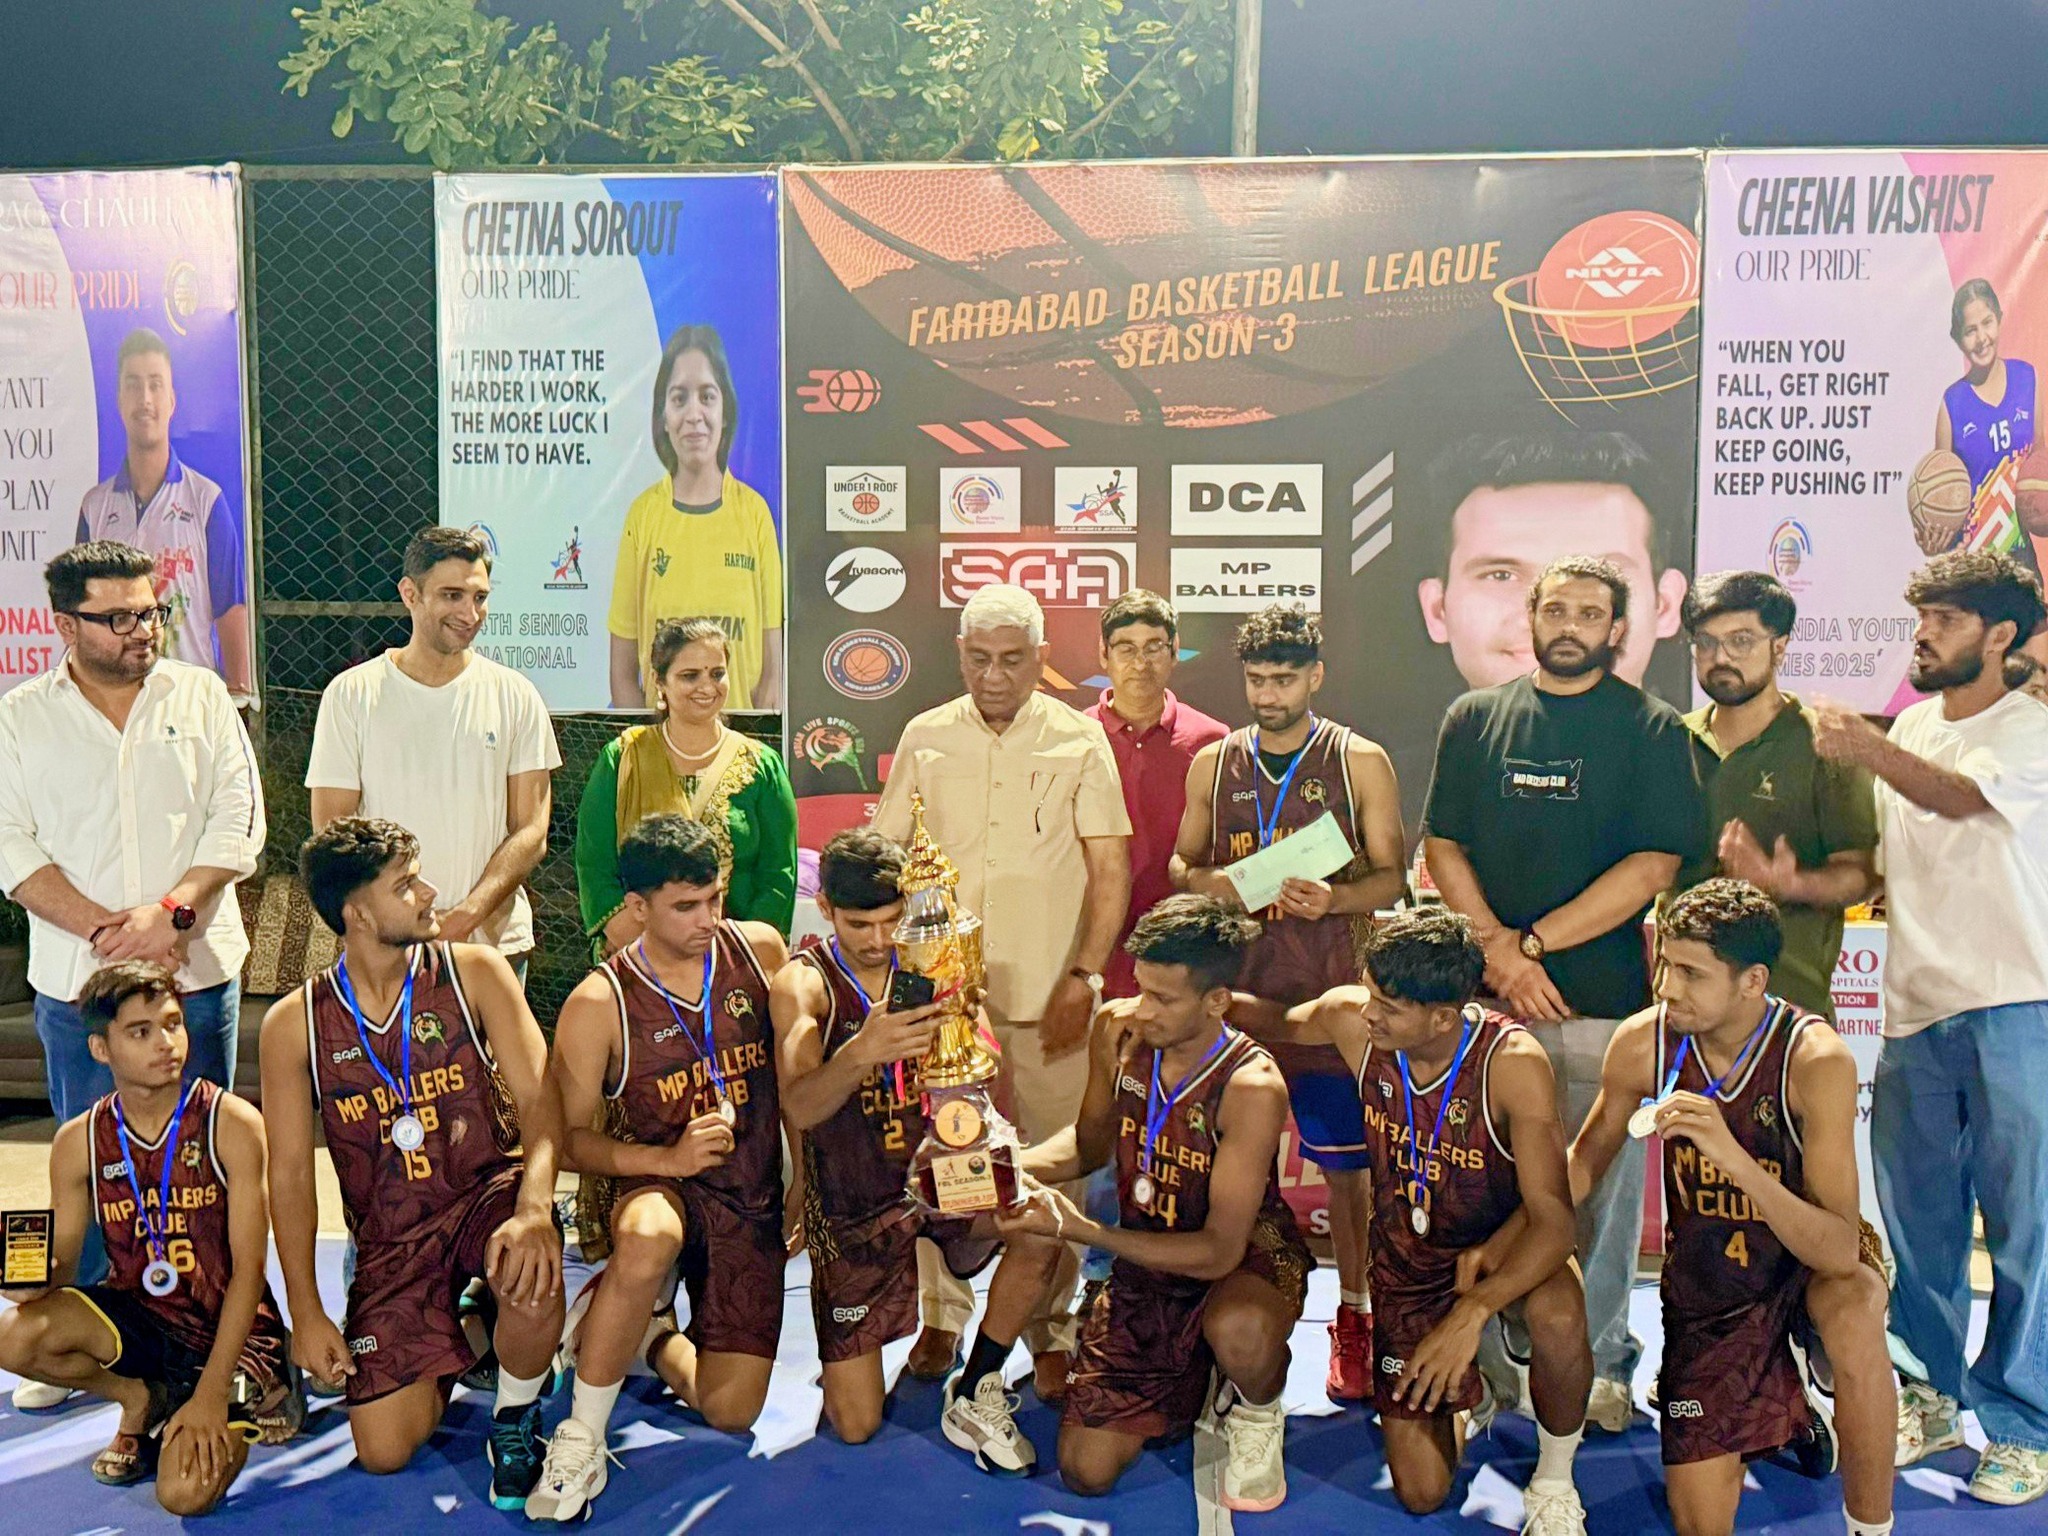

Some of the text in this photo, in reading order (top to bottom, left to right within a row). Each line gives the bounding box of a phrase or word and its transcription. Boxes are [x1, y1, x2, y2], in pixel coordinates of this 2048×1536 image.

[1737, 174, 1995, 236] CHEENA VASHIST
[462, 201, 684, 256] CHETNA SOROUT
[1565, 266, 1664, 279] NIVIA
[1735, 248, 1871, 281] OUR PRIDE
[0, 271, 58, 311] OUR
[461, 269, 581, 300] OUR PRIDE
[908, 240, 1501, 347] FARIDABAD BASKETBALL LEAGUE
[1115, 312, 1298, 370] SEASON-3
[1718, 339, 1846, 364] “WHEN YOU
[472, 350, 513, 372] FIND
[519, 350, 564, 372] THAT
[571, 350, 605, 372] THE
[0, 377, 49, 410] ANT
[451, 380, 607, 406] HARDER I WORK,
[1717, 372, 1889, 401] FALL, GET RIGHT
[451, 411, 609, 434] THE MORE LUCK I
[1716, 405, 1871, 430] BACK UP. JUST
[4, 427, 54, 461] YOU
[1988, 419, 2011, 453] 15
[452, 442, 591, 465] SEEM TO HAVE.
[1714, 439, 1851, 466] KEEP GOING,
[834, 482, 865, 493] UNDER
[873, 482, 898, 493] ROOF
[1189, 481, 1307, 512] DCA
[1713, 472, 1764, 496] KEEP
[1771, 471, 1866, 496] PUSHING
[1221, 562, 1272, 575] MP
[1176, 584, 1316, 597] BALLERS
[519, 613, 589, 637] SENIOR
[1790, 617, 1842, 642] NDIA
[0, 646, 53, 674] LIST
[1229, 831, 1253, 858] MP
[1834, 949, 1880, 974] RO
[1837, 1018, 1882, 1036] ARTNE
[656, 1070, 689, 1103] MP
[334, 1094, 369, 1124] MP
[379, 1105, 440, 1145] CB
[883, 1119, 905, 1150] 2
[401, 1144, 433, 1181] 15
[102, 1199, 136, 1223] MP
[1724, 1230, 1749, 1268] 4
